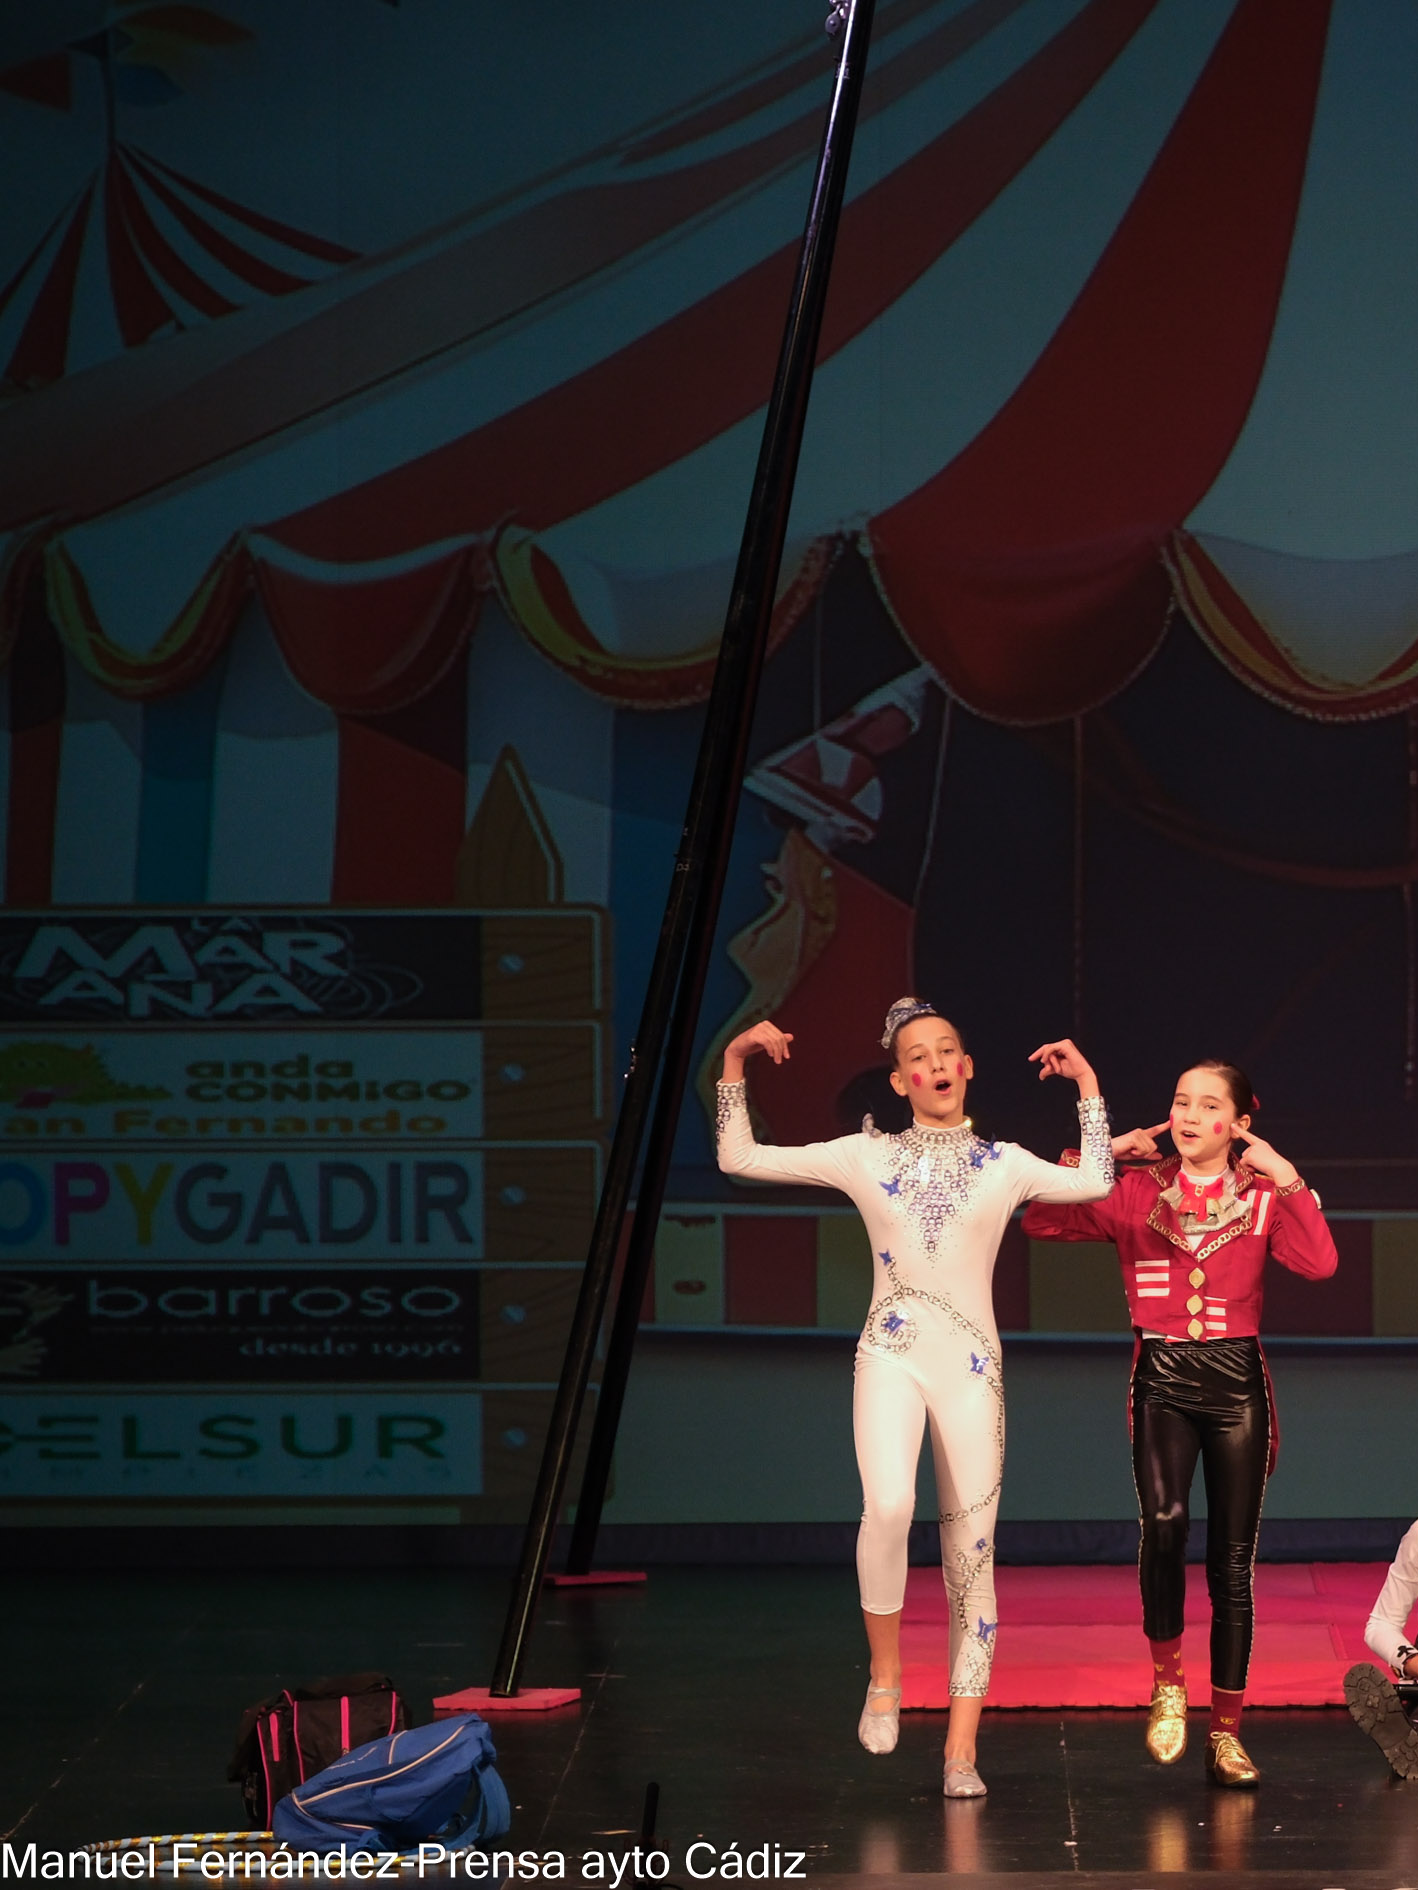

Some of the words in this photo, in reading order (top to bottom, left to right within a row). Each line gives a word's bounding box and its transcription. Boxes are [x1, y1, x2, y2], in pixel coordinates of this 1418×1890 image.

[186, 1054, 354, 1078] anda
[114, 1110, 447, 1134] Fernando
[87, 1280, 461, 1318] barroso
[238, 1337, 357, 1357] desde
[0, 1415, 446, 1460] ELSUR
